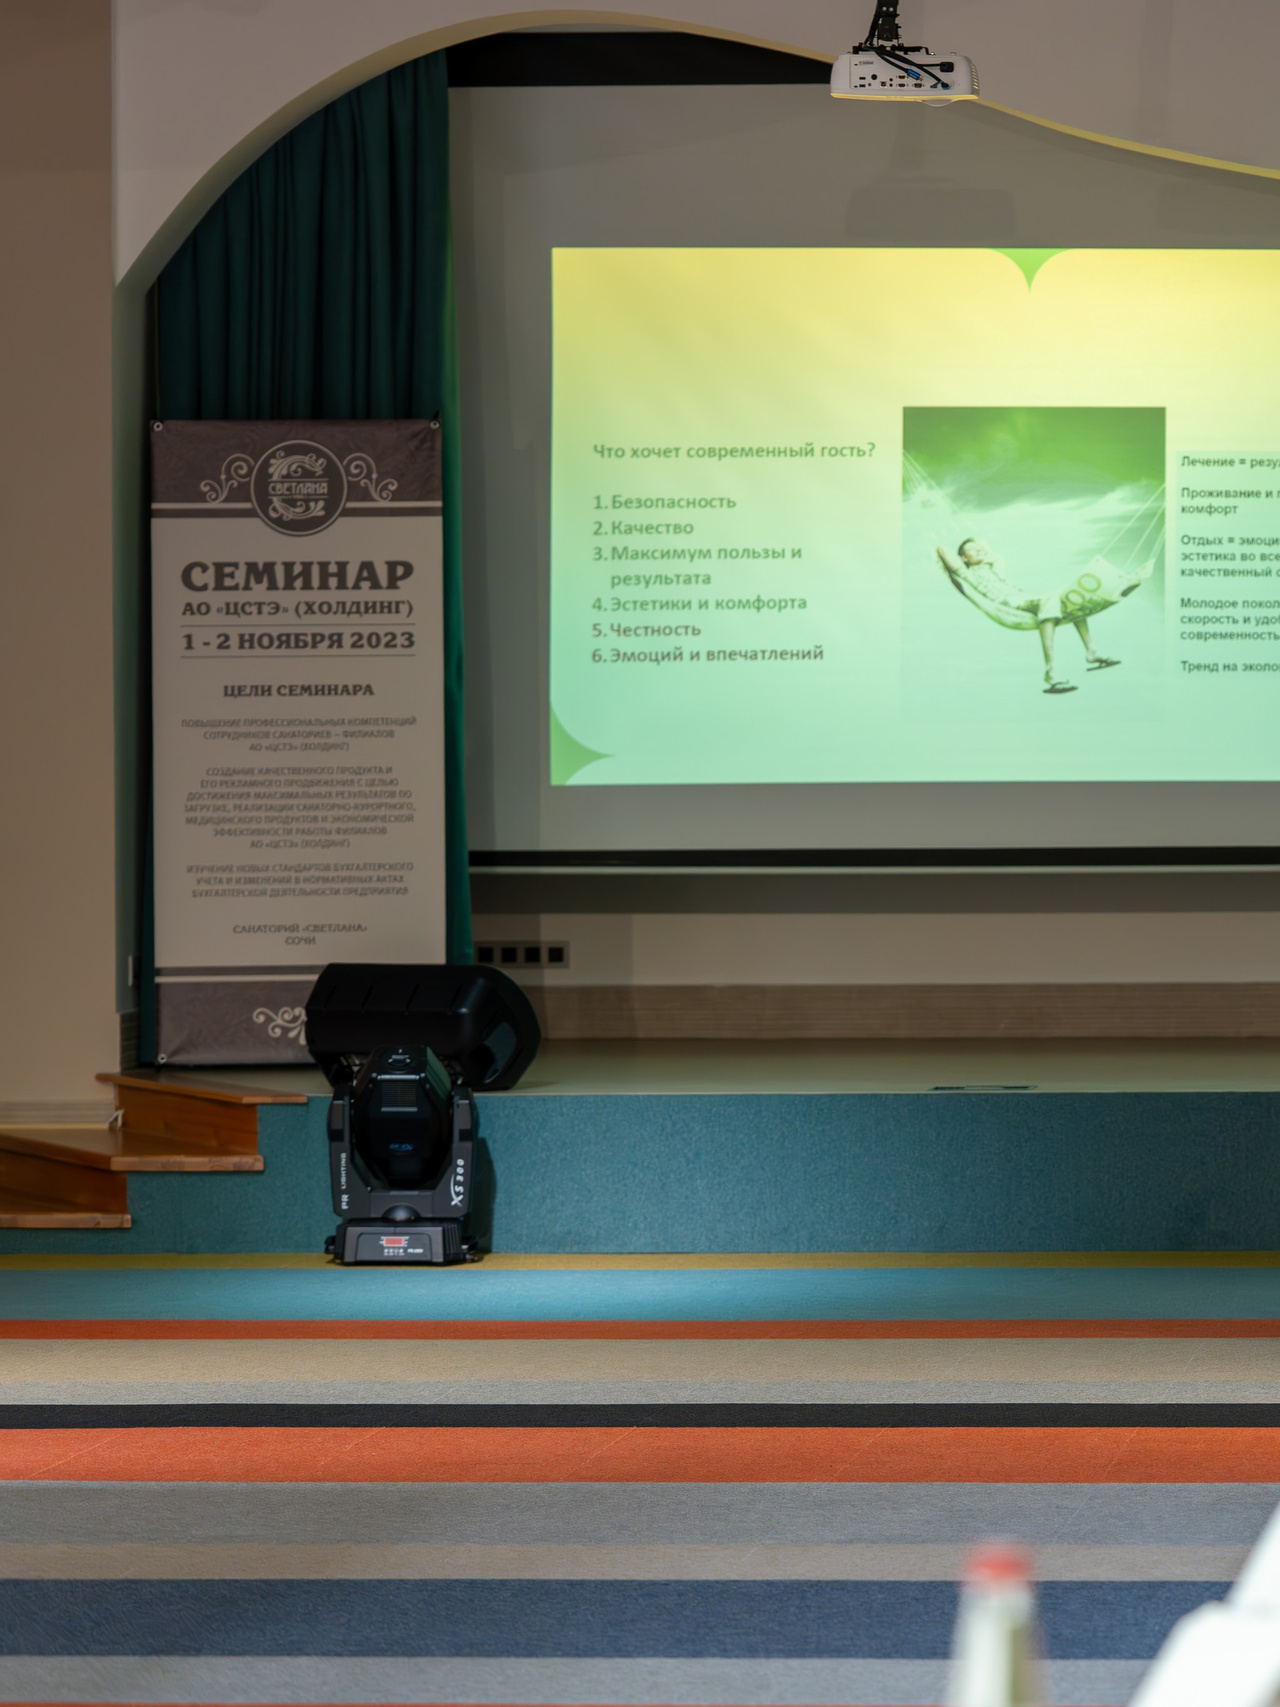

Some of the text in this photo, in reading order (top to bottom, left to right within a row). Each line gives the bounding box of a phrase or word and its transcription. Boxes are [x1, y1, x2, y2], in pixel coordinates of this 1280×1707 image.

[593, 442, 875, 461] Что хочет современный гость?
[1181, 456, 1235, 467] Лечение
[268, 482, 328, 495] СВЕТЛАНА
[1181, 487, 1262, 500] Проживание
[611, 495, 736, 509] Безопасность
[1181, 503, 1237, 516] комфорт
[611, 521, 694, 535] Качество
[1181, 535, 1223, 546] Отдых
[611, 546, 712, 563] Максимум
[717, 548, 785, 559] пользы
[791, 548, 802, 558] и
[1181, 553, 1236, 561] эстетика
[1240, 553, 1256, 561] во
[181, 560, 414, 592] СЕМИНАР
[1180, 567, 1272, 577] качественный
[610, 574, 711, 589] результата
[182, 600, 414, 618] АО «ЦСТЭ» (ХОЛДИНГ)
[611, 597, 692, 611] Эстетики
[698, 600, 709, 610] и
[715, 594, 807, 613] комфорта
[1180, 597, 1238, 609] Молодое
[1180, 616, 1239, 626] скорость
[1242, 616, 1251, 624] и
[610, 623, 701, 637] Честность
[1180, 631, 1280, 642] современность
[183, 634, 195, 650] 1
[217, 633, 230, 649] 2
[238, 632, 343, 649] НОЯБРЯ
[351, 632, 414, 649] 2023
[611, 646, 684, 665] Эмоций
[689, 651, 700, 661] и
[706, 645, 824, 661] впечатлений
[1181, 660, 1219, 673] Тренд
[1222, 663, 1238, 671] на
[223, 684, 373, 698] ЦЕЛИ СЕМИНАРА
[233, 923, 367, 933] САНАТОРИЙ «СВЕТЛАНА»
[285, 936, 316, 945] СОЧИ
[341, 1194, 349, 1210] PR
